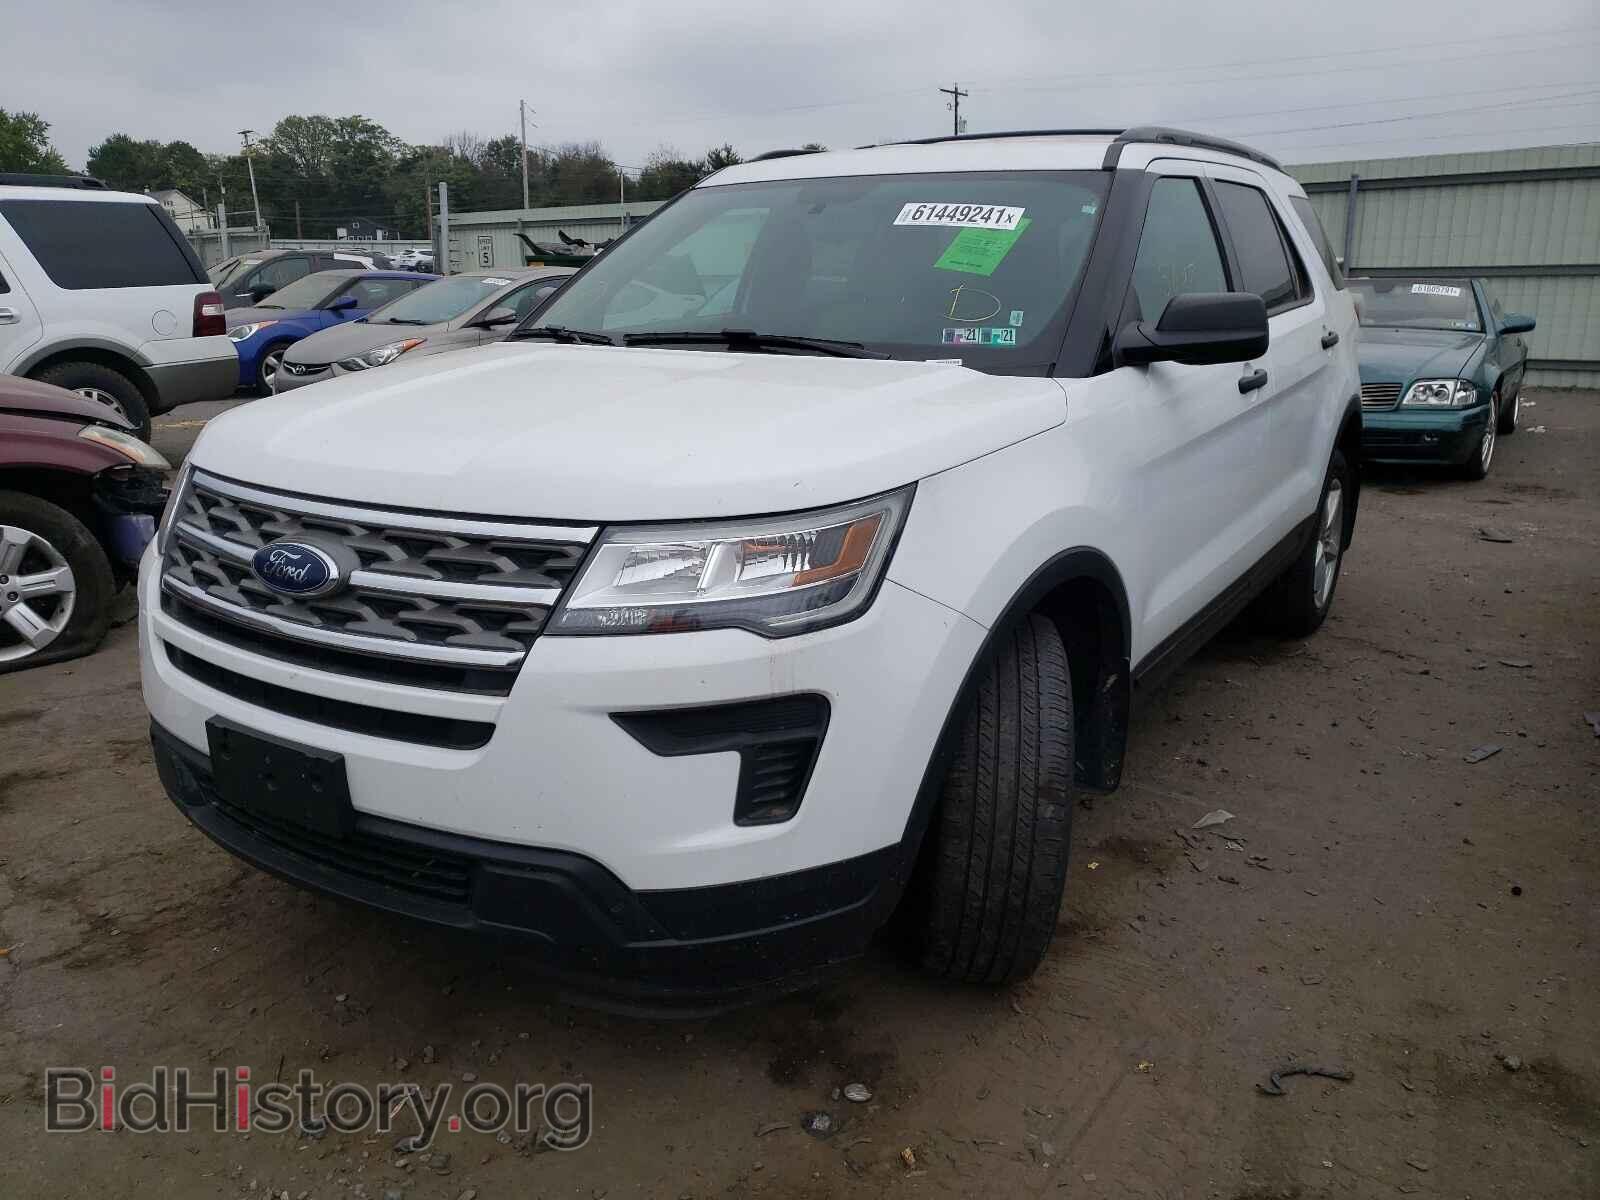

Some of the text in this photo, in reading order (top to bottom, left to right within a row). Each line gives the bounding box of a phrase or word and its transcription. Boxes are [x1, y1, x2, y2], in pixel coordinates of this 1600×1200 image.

[483, 252, 489, 263] 5
[966, 328, 977, 341] 21
[1003, 329, 1013, 342] 21
[263, 549, 312, 582] Ford
